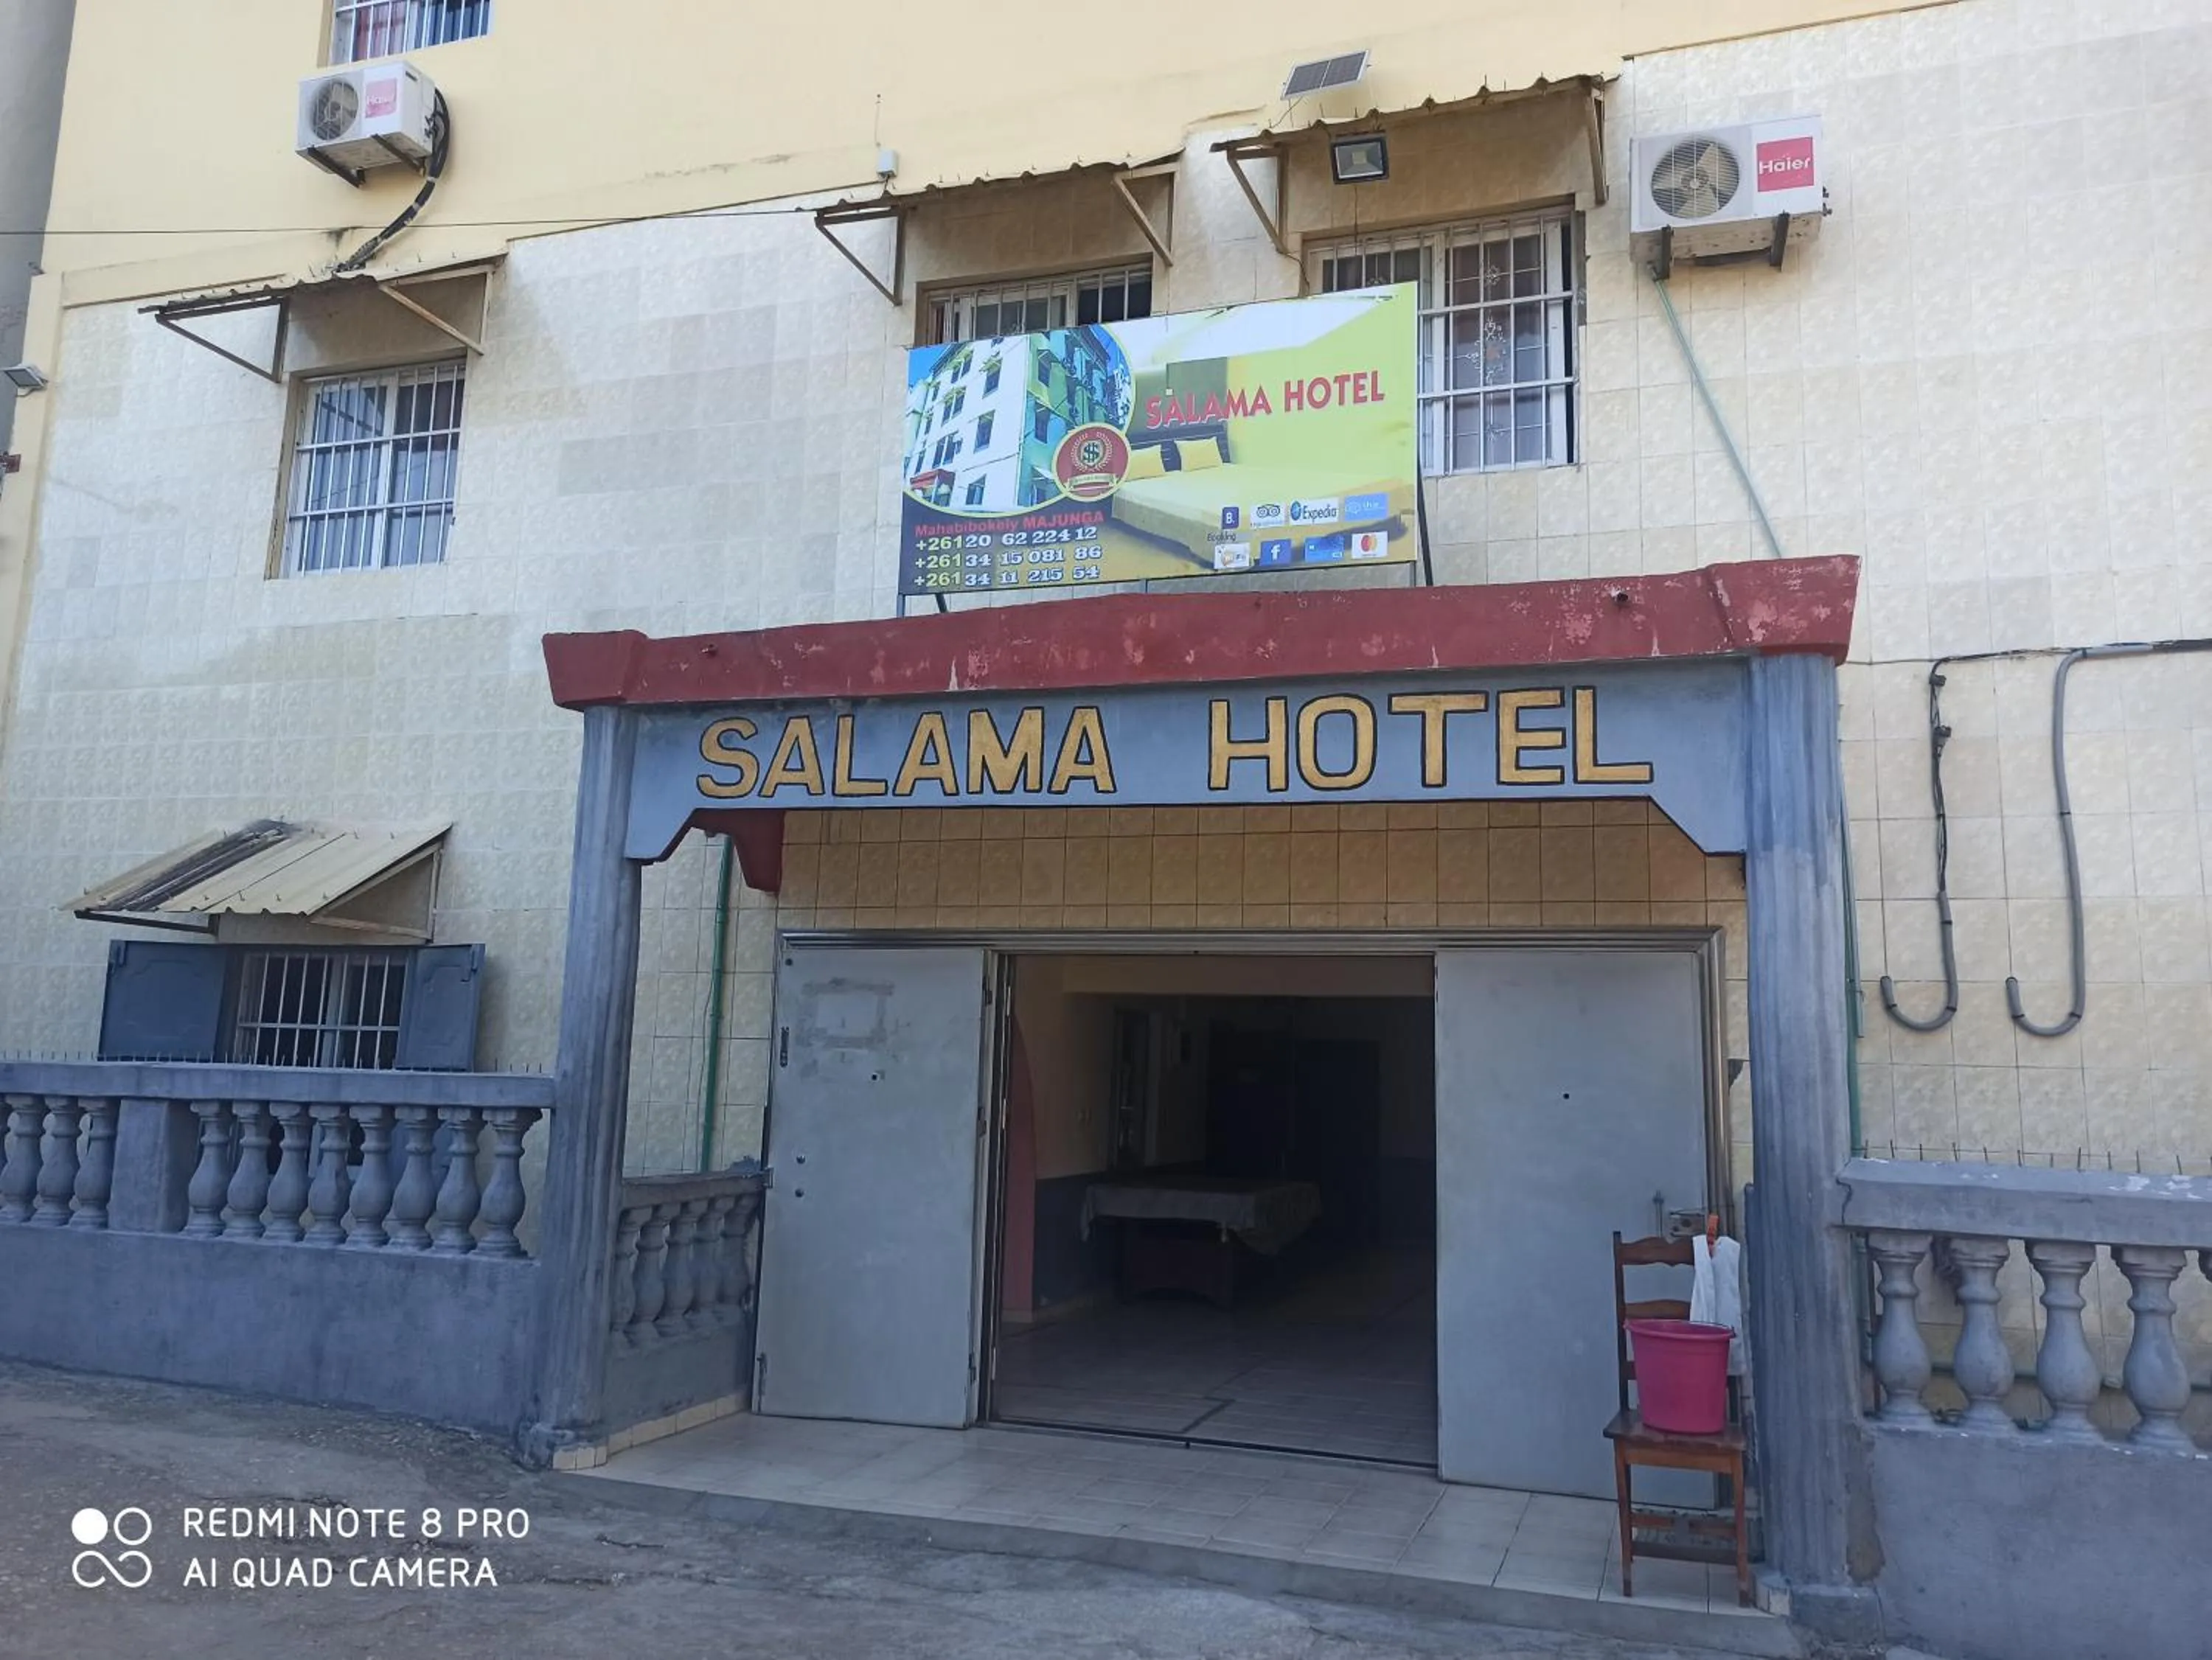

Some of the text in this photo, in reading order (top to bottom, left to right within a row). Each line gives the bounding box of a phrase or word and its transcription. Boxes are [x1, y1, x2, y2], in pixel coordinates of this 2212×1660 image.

[1759, 156, 1810, 175] Haier
[1147, 370, 1385, 430] SALAMA HOTEL
[1023, 511, 1104, 529] MAJUNGA
[1302, 503, 1338, 522] Expedia
[916, 526, 1097, 551] +261 20 62 224 12
[915, 545, 1102, 569] +261 34 15 081 86
[914, 566, 1099, 587] +261 34 11 215 54
[696, 686, 1654, 799] SALAMA HOTEL
